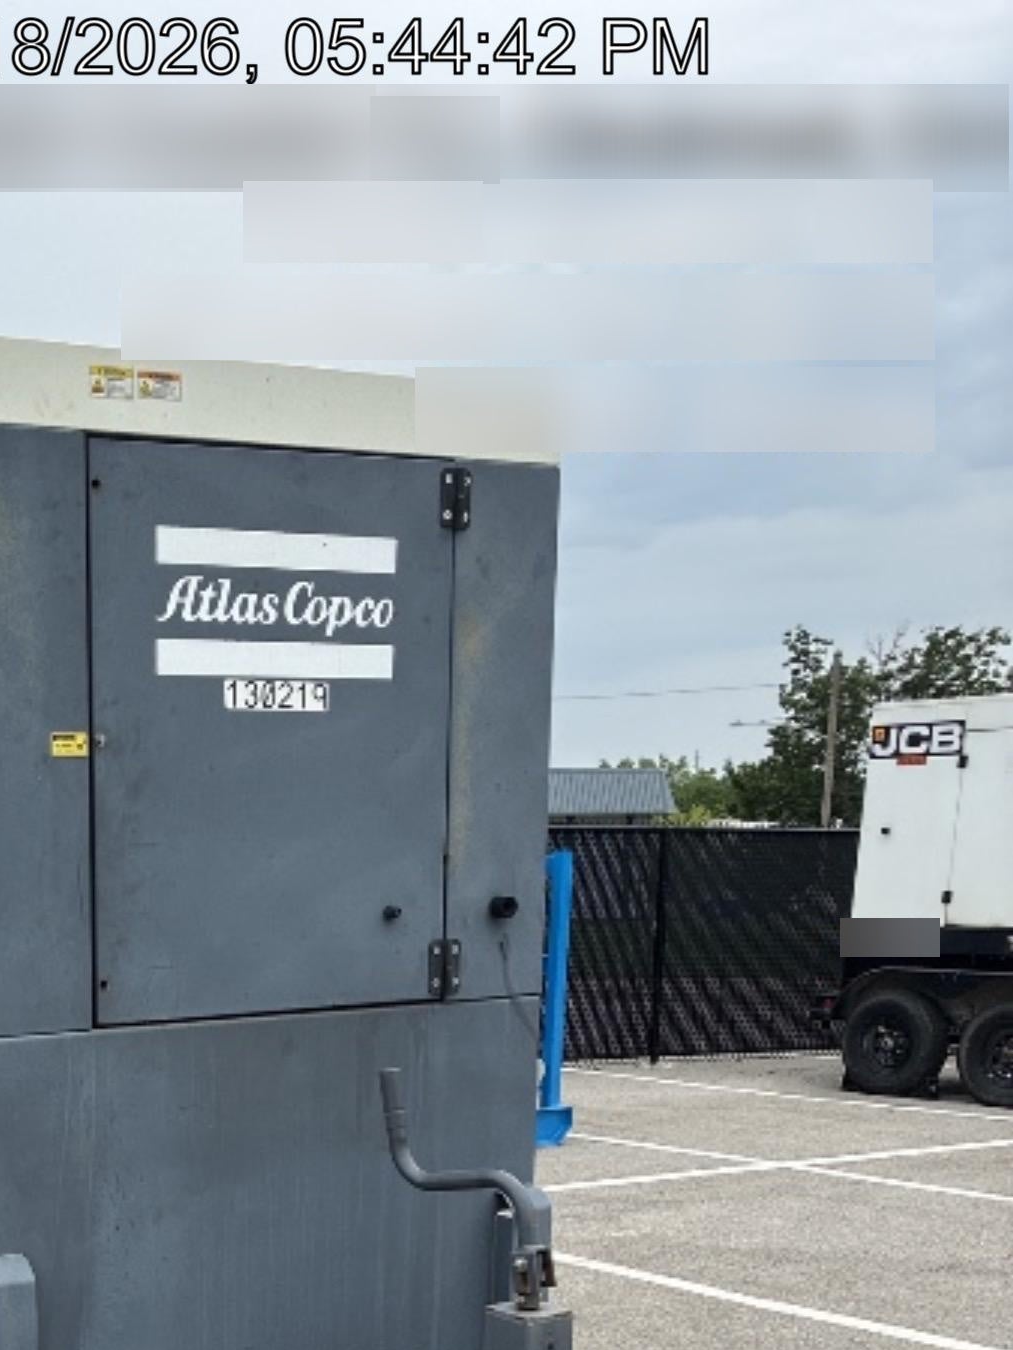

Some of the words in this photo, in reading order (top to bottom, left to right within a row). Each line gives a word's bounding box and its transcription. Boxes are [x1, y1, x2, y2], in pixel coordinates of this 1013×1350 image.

[156, 575, 279, 625] Atlas
[284, 581, 394, 637] Copco
[225, 680, 328, 710] 130219
[871, 722, 961, 757] JCB
